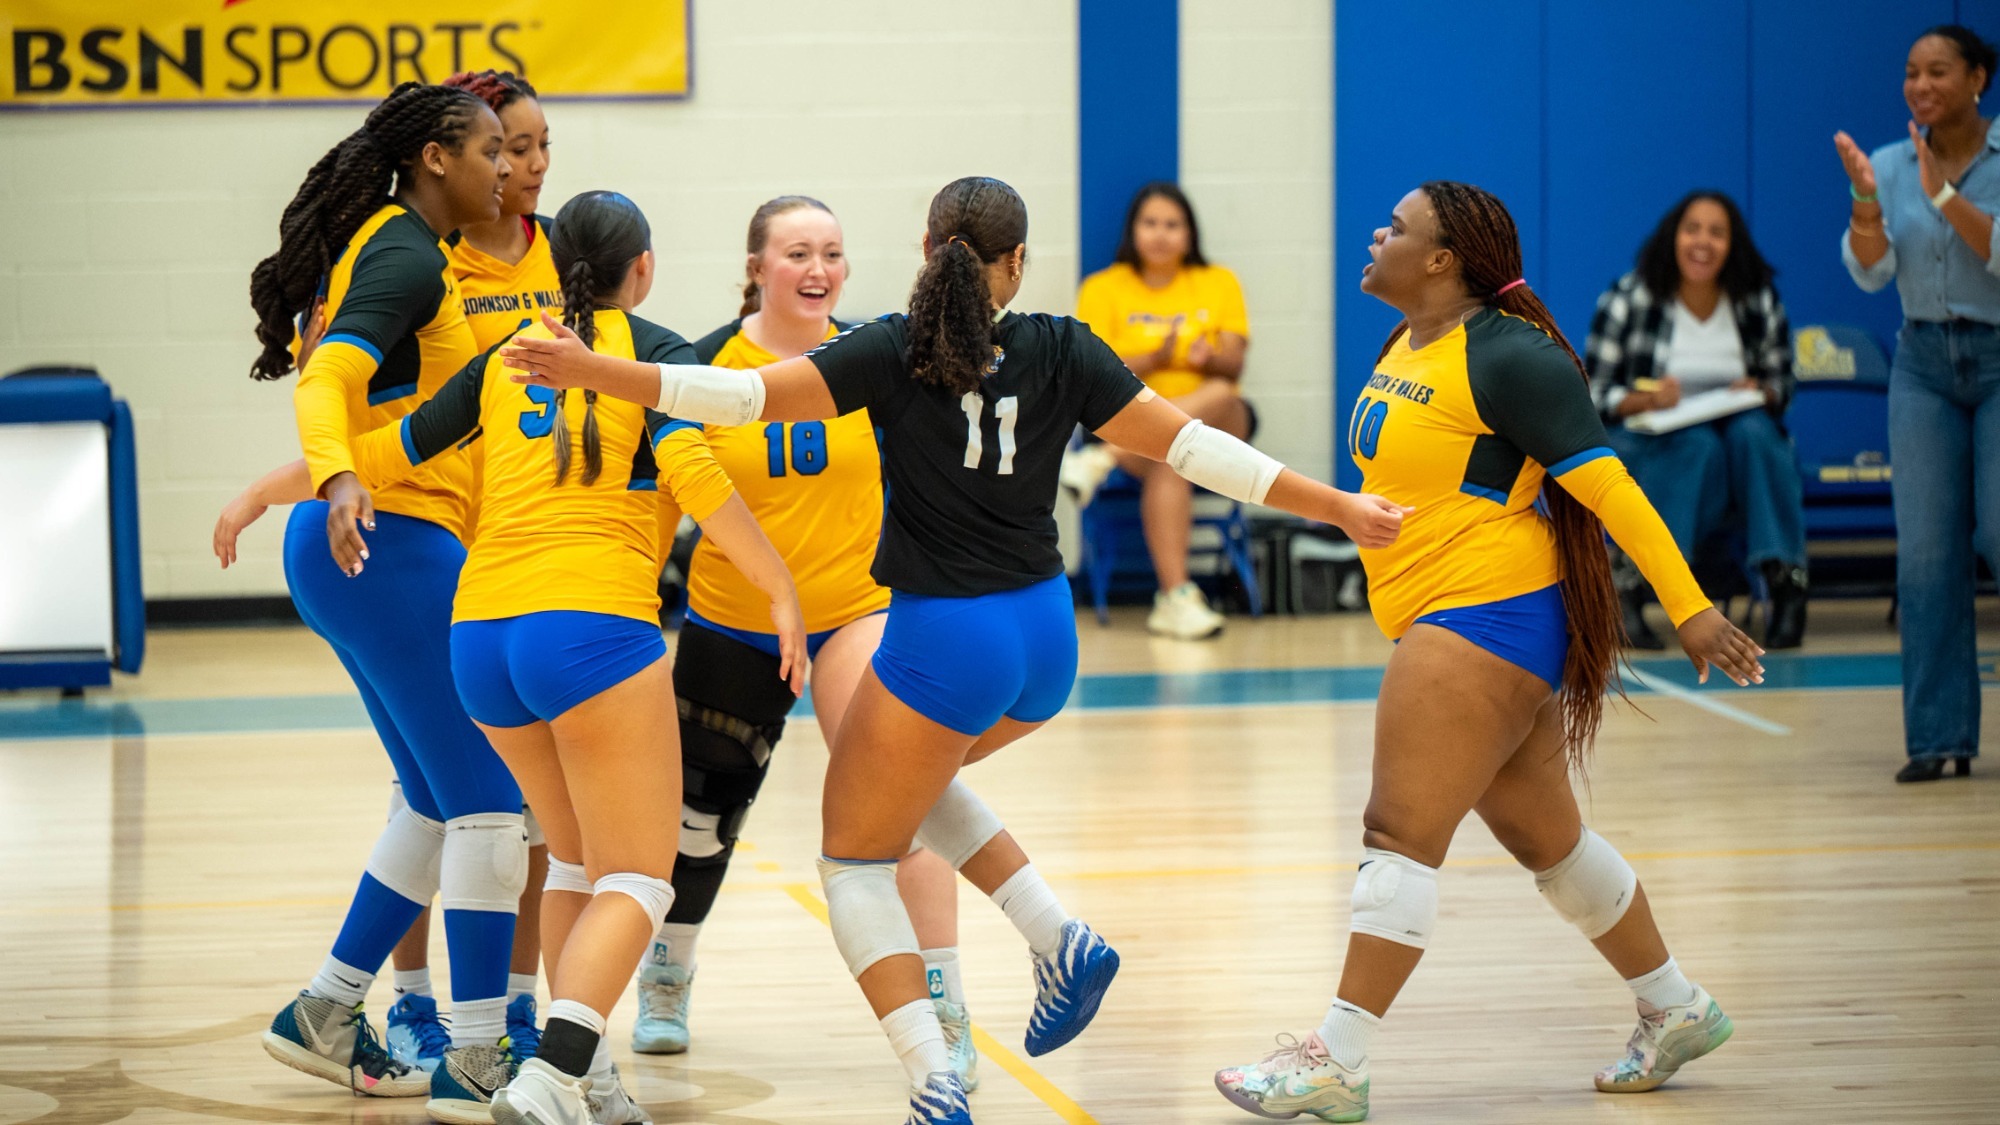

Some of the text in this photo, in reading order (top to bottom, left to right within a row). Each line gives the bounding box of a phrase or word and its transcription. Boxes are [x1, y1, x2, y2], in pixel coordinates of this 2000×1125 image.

[13, 20, 527, 95] BSN SPORTS
[463, 294, 520, 316] JOHNSON
[522, 292, 532, 310] &
[1395, 380, 1435, 405] WALES
[764, 421, 828, 478] 18
[961, 391, 1018, 475] 11
[1351, 396, 1389, 461] 10
